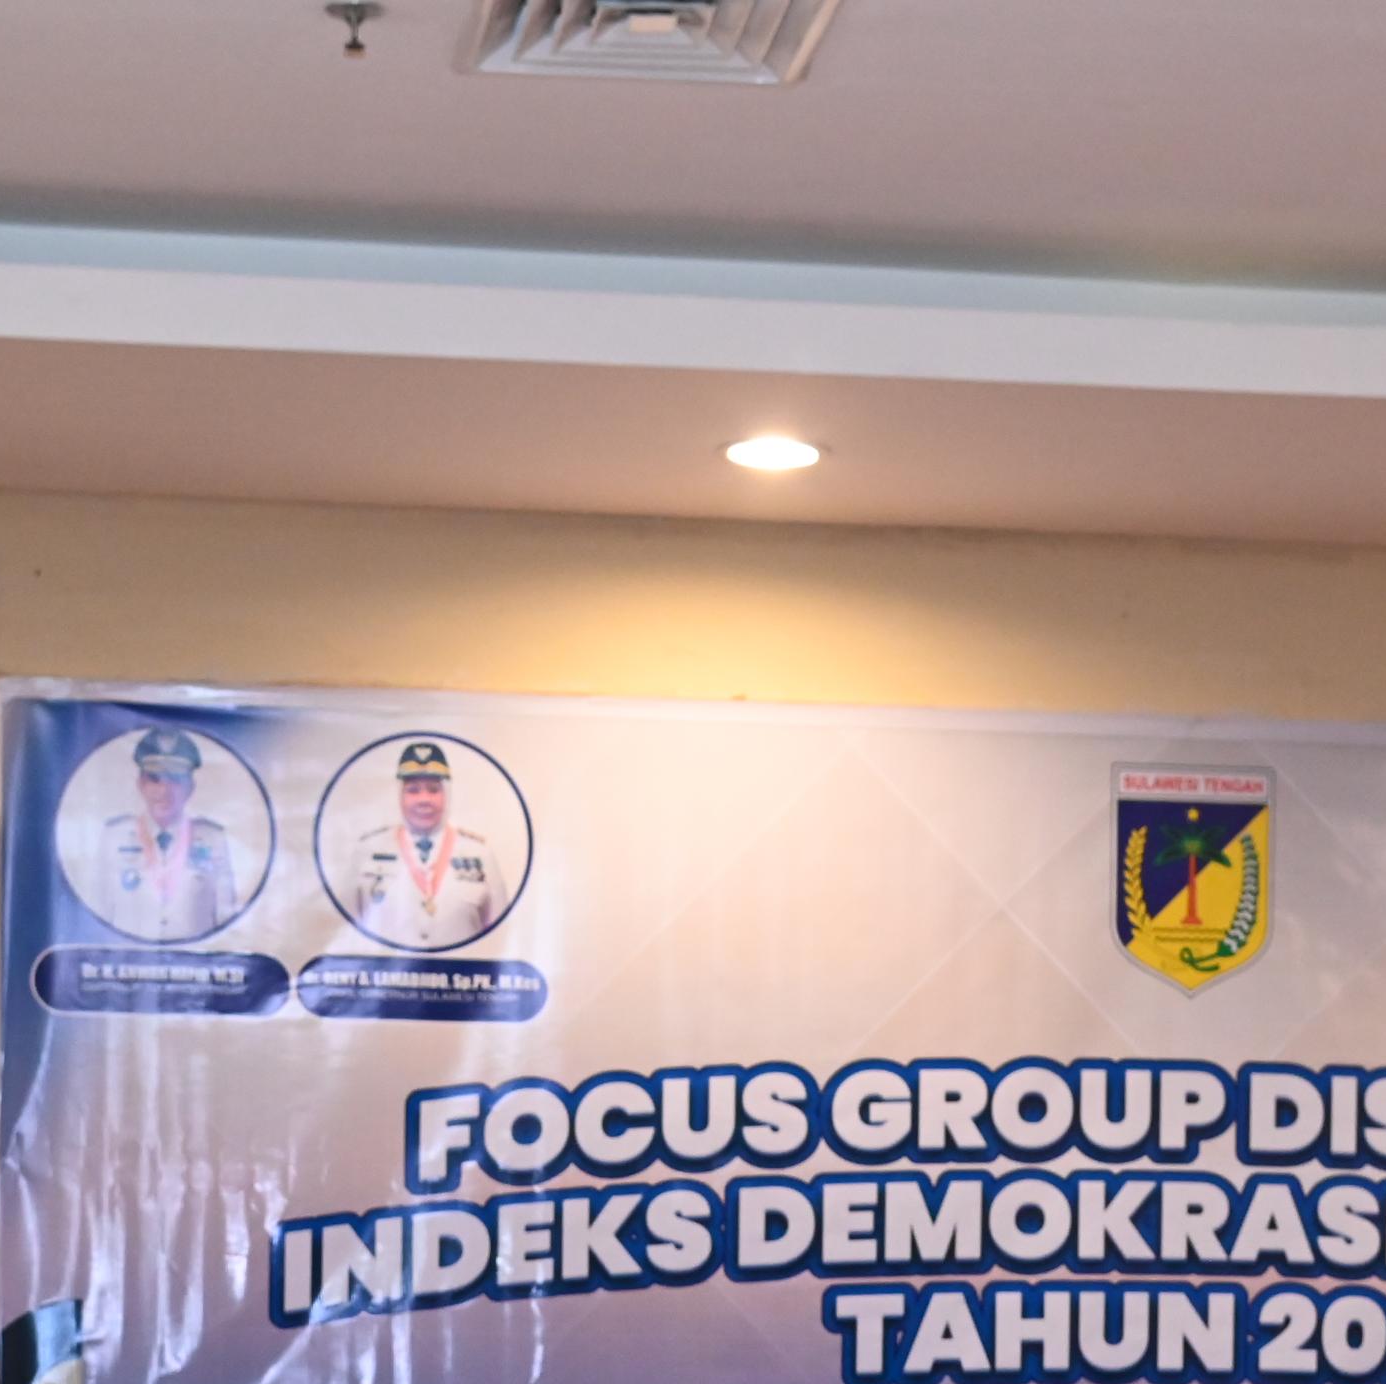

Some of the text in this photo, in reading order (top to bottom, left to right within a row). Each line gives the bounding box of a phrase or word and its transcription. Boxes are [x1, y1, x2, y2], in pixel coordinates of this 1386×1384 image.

[410, 1063, 813, 1190] FOCUS
[825, 1061, 1233, 1158] GROUP
[275, 1185, 718, 1322] INDEKS
[830, 1284, 1240, 1382] TAHUN
